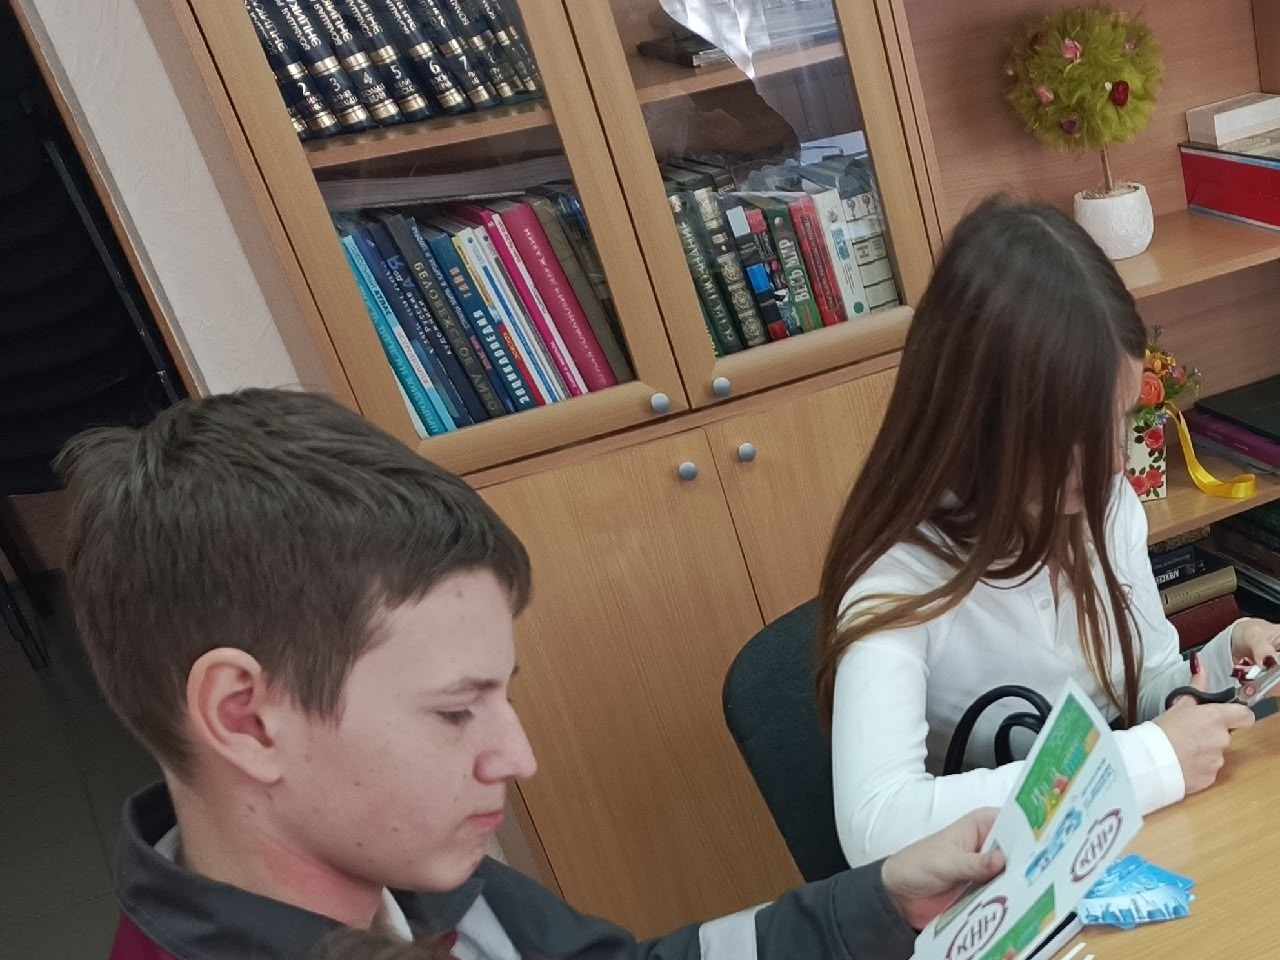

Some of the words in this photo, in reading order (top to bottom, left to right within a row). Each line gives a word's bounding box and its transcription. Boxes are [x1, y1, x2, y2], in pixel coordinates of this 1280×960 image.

[363, 71, 373, 84] 4
[390, 64, 402, 79] 5
[429, 60, 441, 75] 6
[329, 77, 341, 92] 3
[778, 238, 800, 267] МИР
[680, 220, 734, 342] ЕСТЕСТВОЗНАНИЕ
[788, 270, 810, 302] ВЕСЬ
[373, 288, 392, 317] АТЛАС
[412, 260, 474, 366] БЕЛОВЕЖСКОЕ
[470, 370, 499, 412] ДИВО
[471, 307, 530, 405] ЭНЦИКЛОПЕДИЯ
[956, 912, 996, 955] КНН
